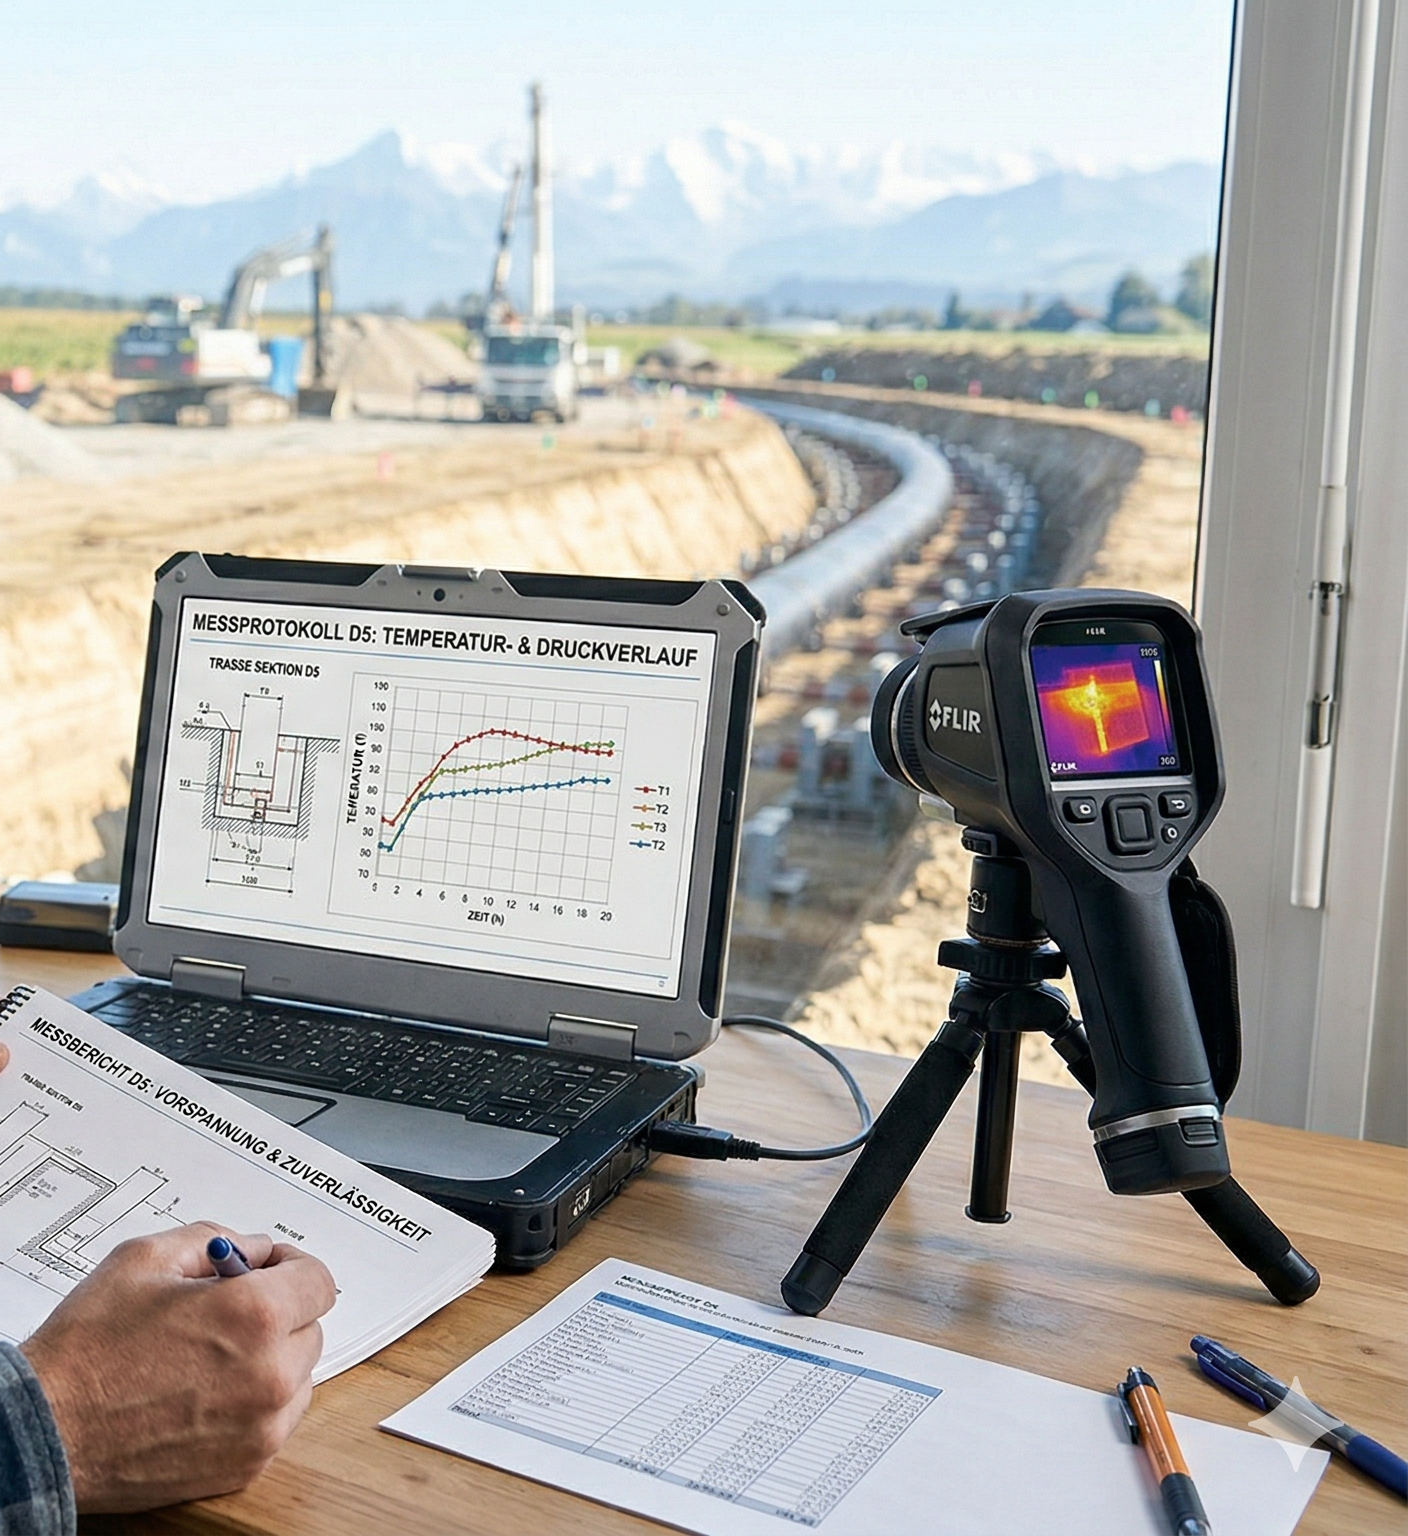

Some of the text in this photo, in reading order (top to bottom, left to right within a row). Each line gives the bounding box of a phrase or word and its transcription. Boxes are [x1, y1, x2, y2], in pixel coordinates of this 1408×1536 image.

[192, 613, 698, 667] MESSPROTOKOLL D5: TEMPERATUR- & DRUCKVERLAUF
[209, 657, 320, 678] TRASSE SEKTION D5
[942, 705, 982, 734] FLIR
[658, 785, 670, 796] T1
[656, 803, 669, 815] T2
[654, 821, 667, 833] T3
[652, 839, 666, 851] T2
[358, 868, 369, 879] 70
[393, 885, 400, 895] 2
[483, 896, 494, 907] 10
[506, 899, 517, 910] 12
[529, 902, 540, 912] 14
[553, 905, 563, 916] 16
[576, 908, 588, 918] 18
[600, 911, 612, 922] 20
[28, 1017, 132, 1079] MESSBERICHT
[127, 1071, 154, 1094] D5:
[154, 1085, 269, 1155] VORSPANNUNG
[266, 1148, 282, 1164] &
[278, 1155, 432, 1243] ZUVERLÄSSIGKEIT
